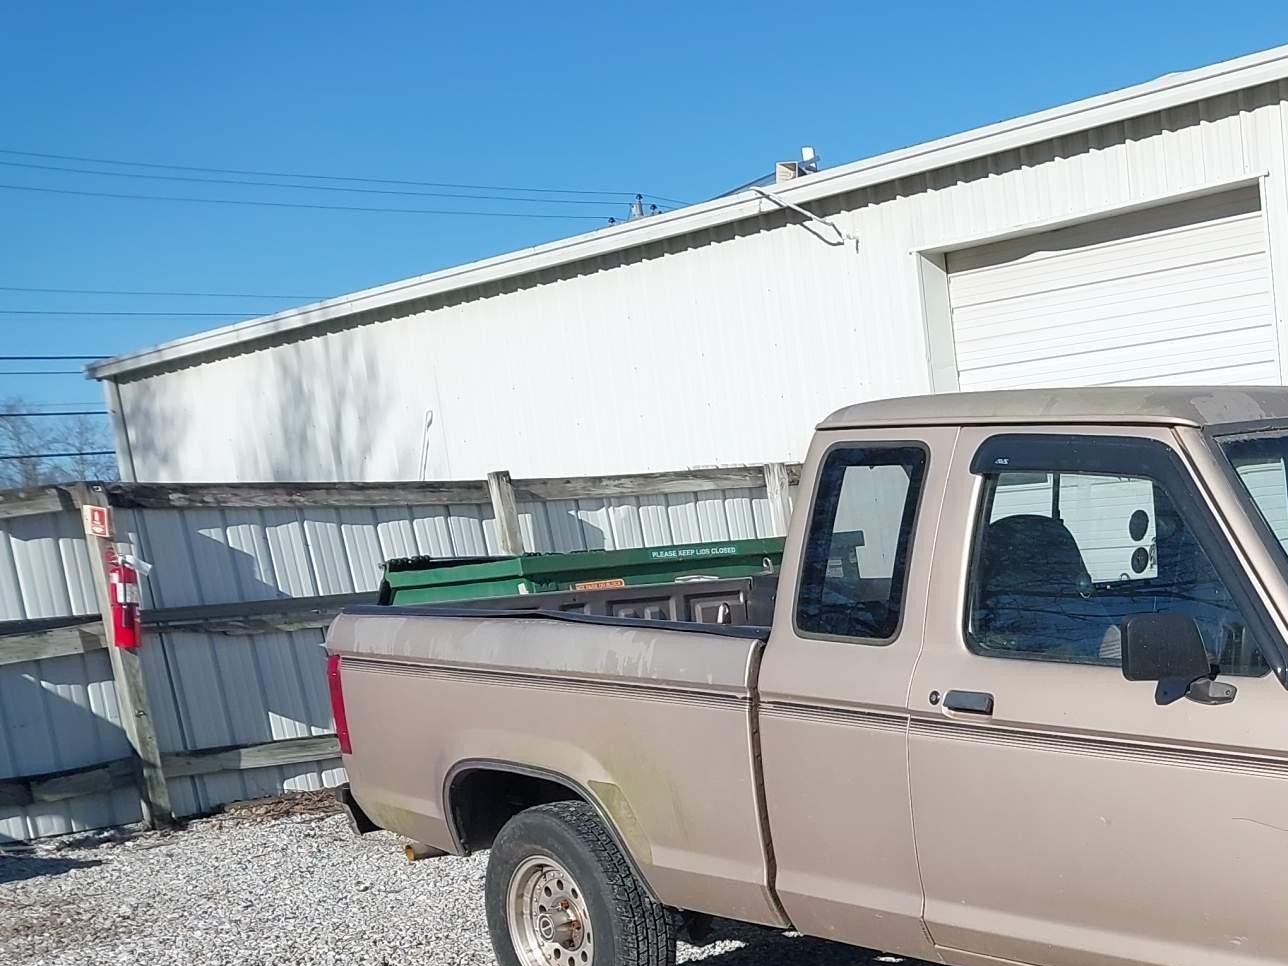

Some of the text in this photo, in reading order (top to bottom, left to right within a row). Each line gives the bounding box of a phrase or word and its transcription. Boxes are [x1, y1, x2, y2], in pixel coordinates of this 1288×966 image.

[652, 550, 677, 558] PLEASE
[678, 548, 695, 556] KEEP
[711, 546, 736, 554] CLOSED
